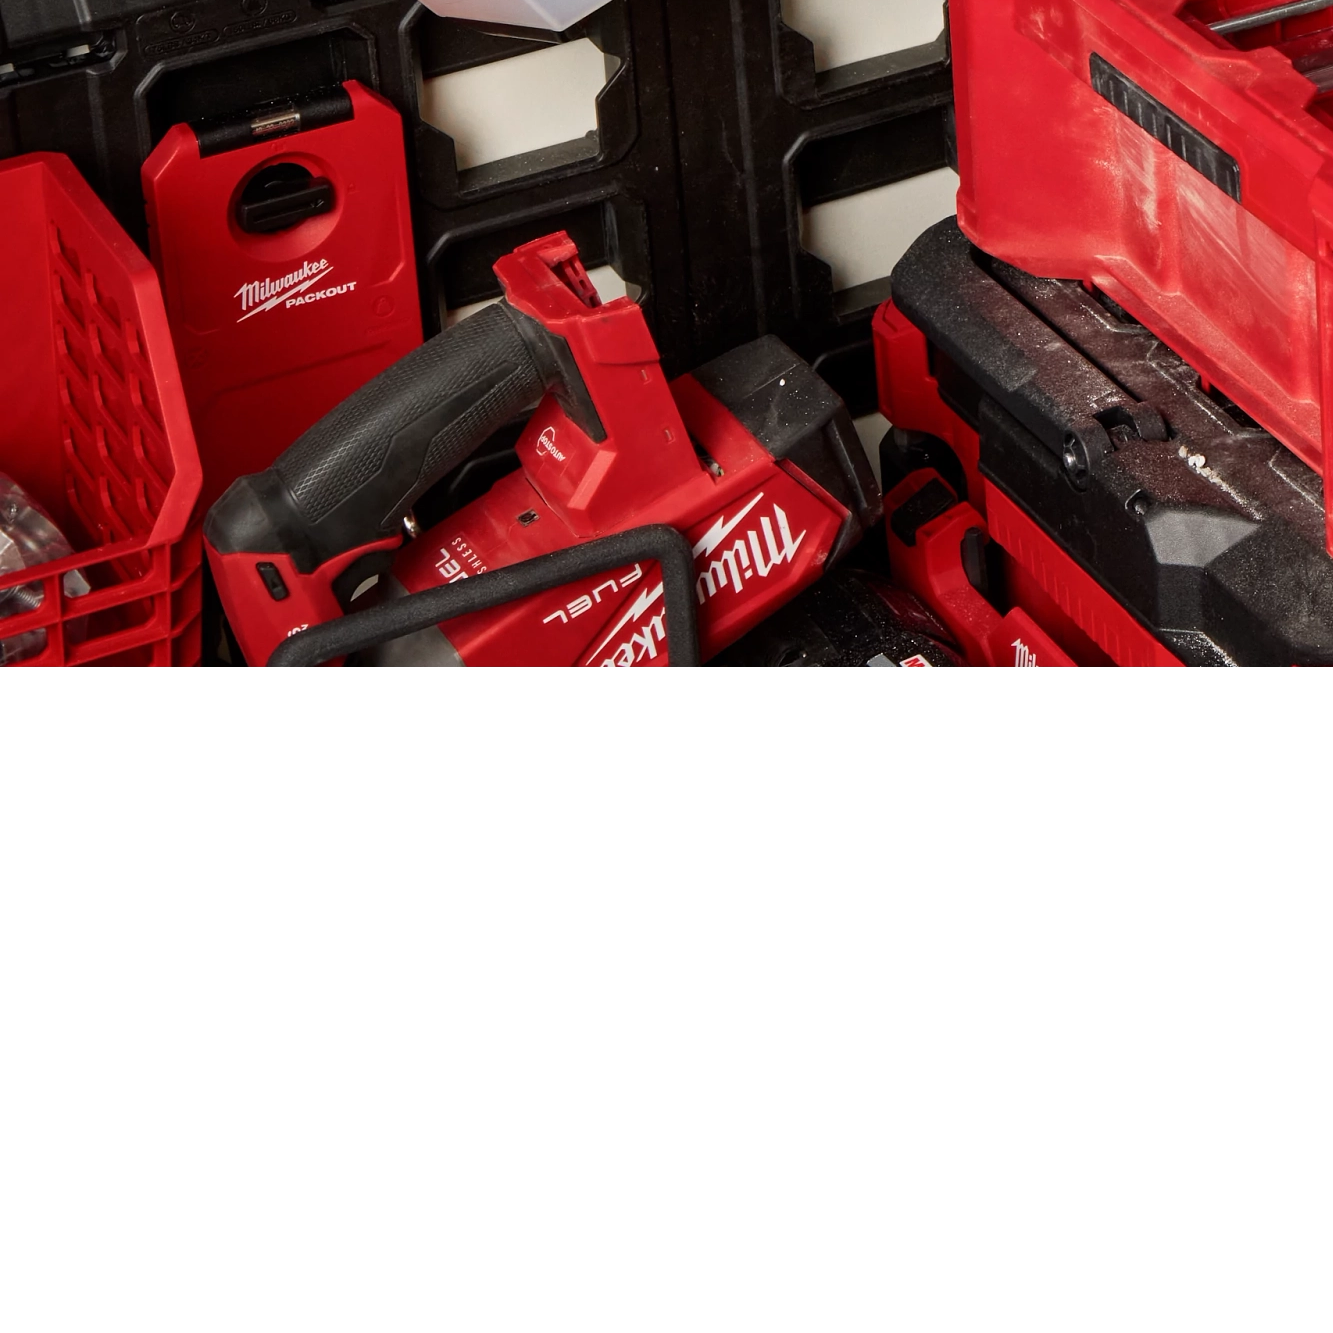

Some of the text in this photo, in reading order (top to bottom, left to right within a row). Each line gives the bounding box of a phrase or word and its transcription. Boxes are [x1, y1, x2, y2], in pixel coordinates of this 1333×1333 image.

[234, 256, 330, 309] Milwaukee
[285, 282, 357, 308] PACKOUT
[540, 435, 566, 462] AUTOSTOP
[542, 563, 642, 626] FUEL
